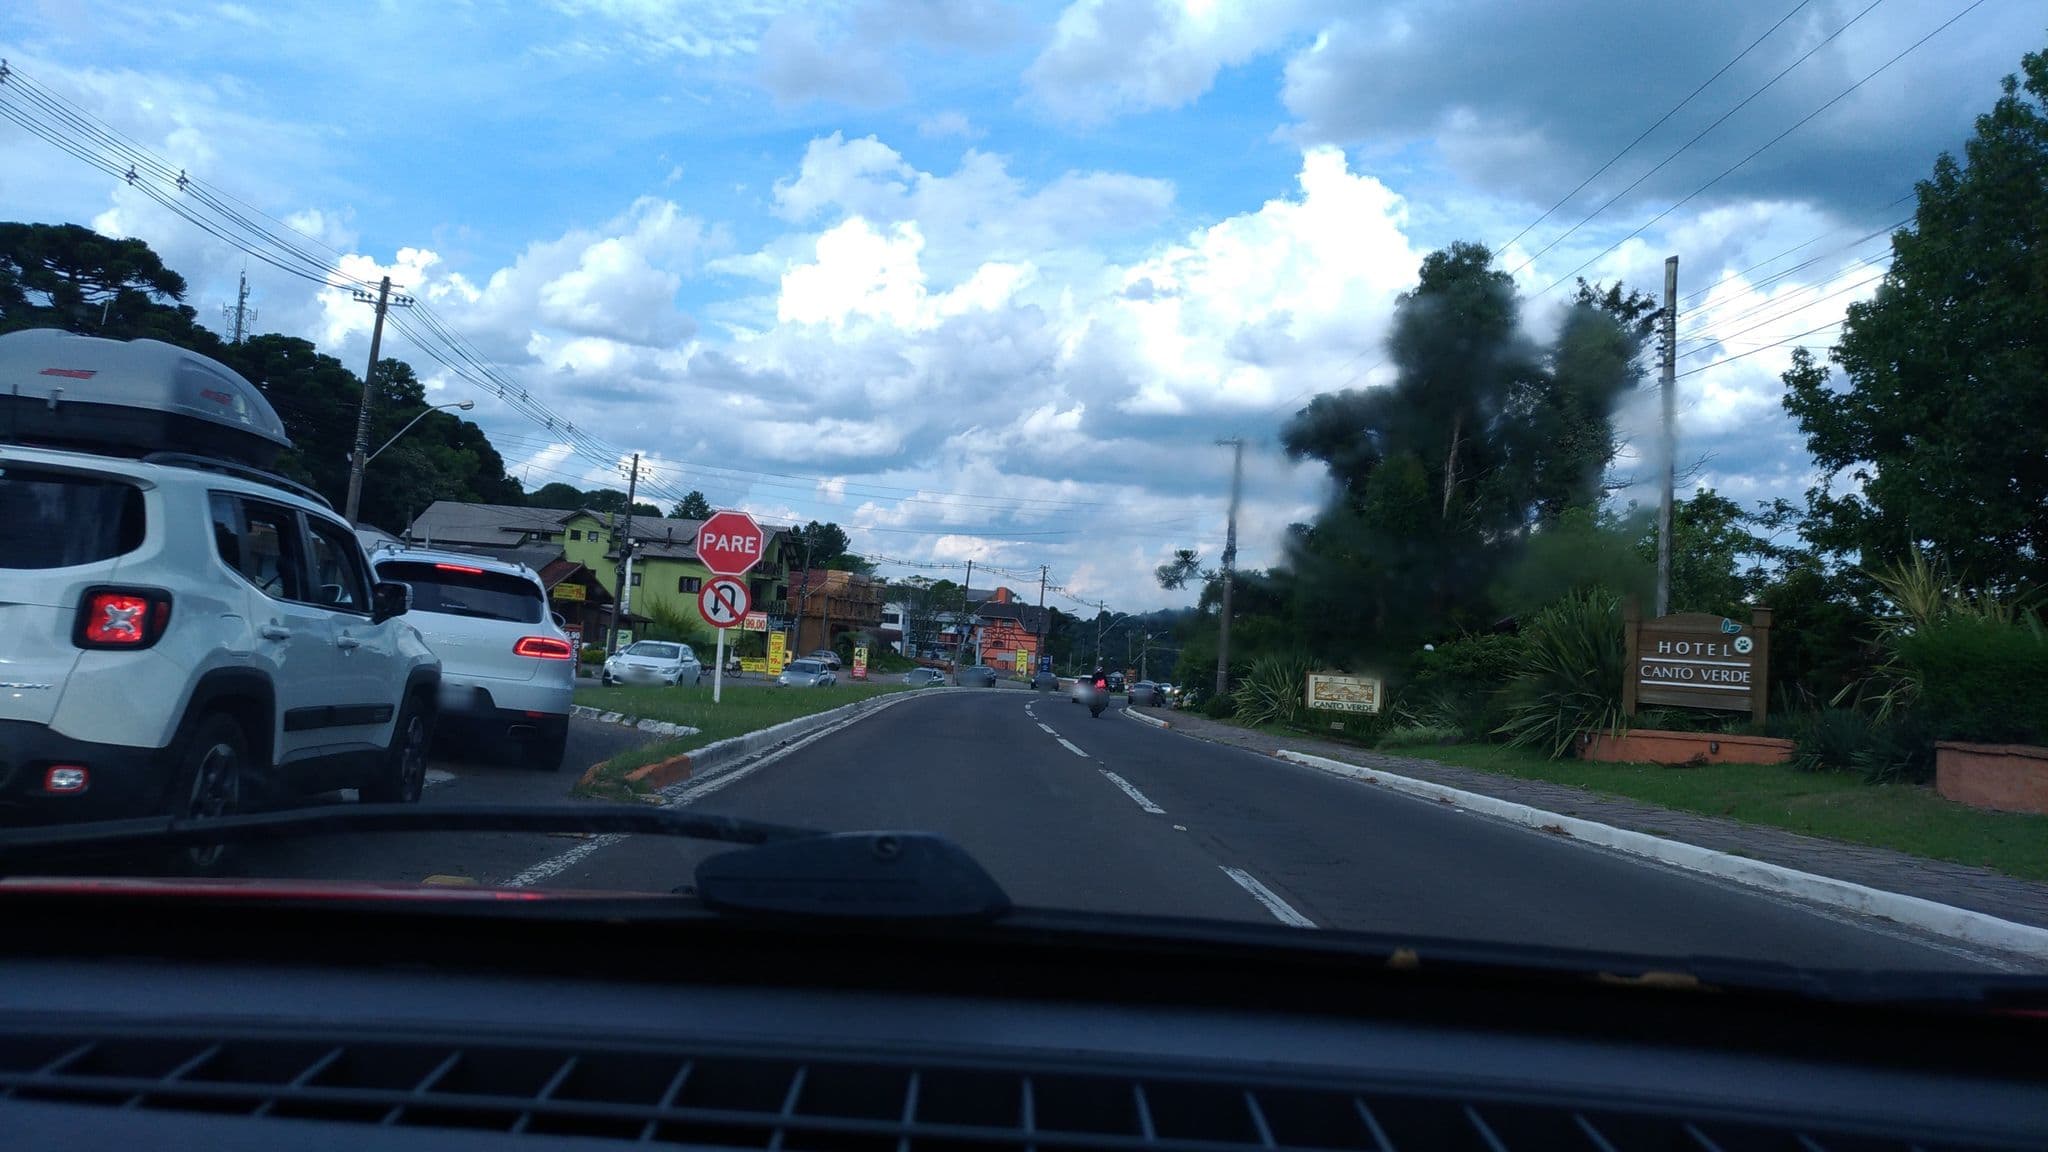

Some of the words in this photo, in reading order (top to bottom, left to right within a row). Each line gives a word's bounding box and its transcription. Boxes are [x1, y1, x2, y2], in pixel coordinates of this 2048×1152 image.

[703, 533, 757, 554] PARE
[1658, 641, 1732, 657] HOTEL
[1640, 665, 1694, 680] CANTO
[1701, 669, 1752, 683] VERDE
[1314, 701, 1345, 711] CANTO
[1346, 704, 1375, 712] VERDE
